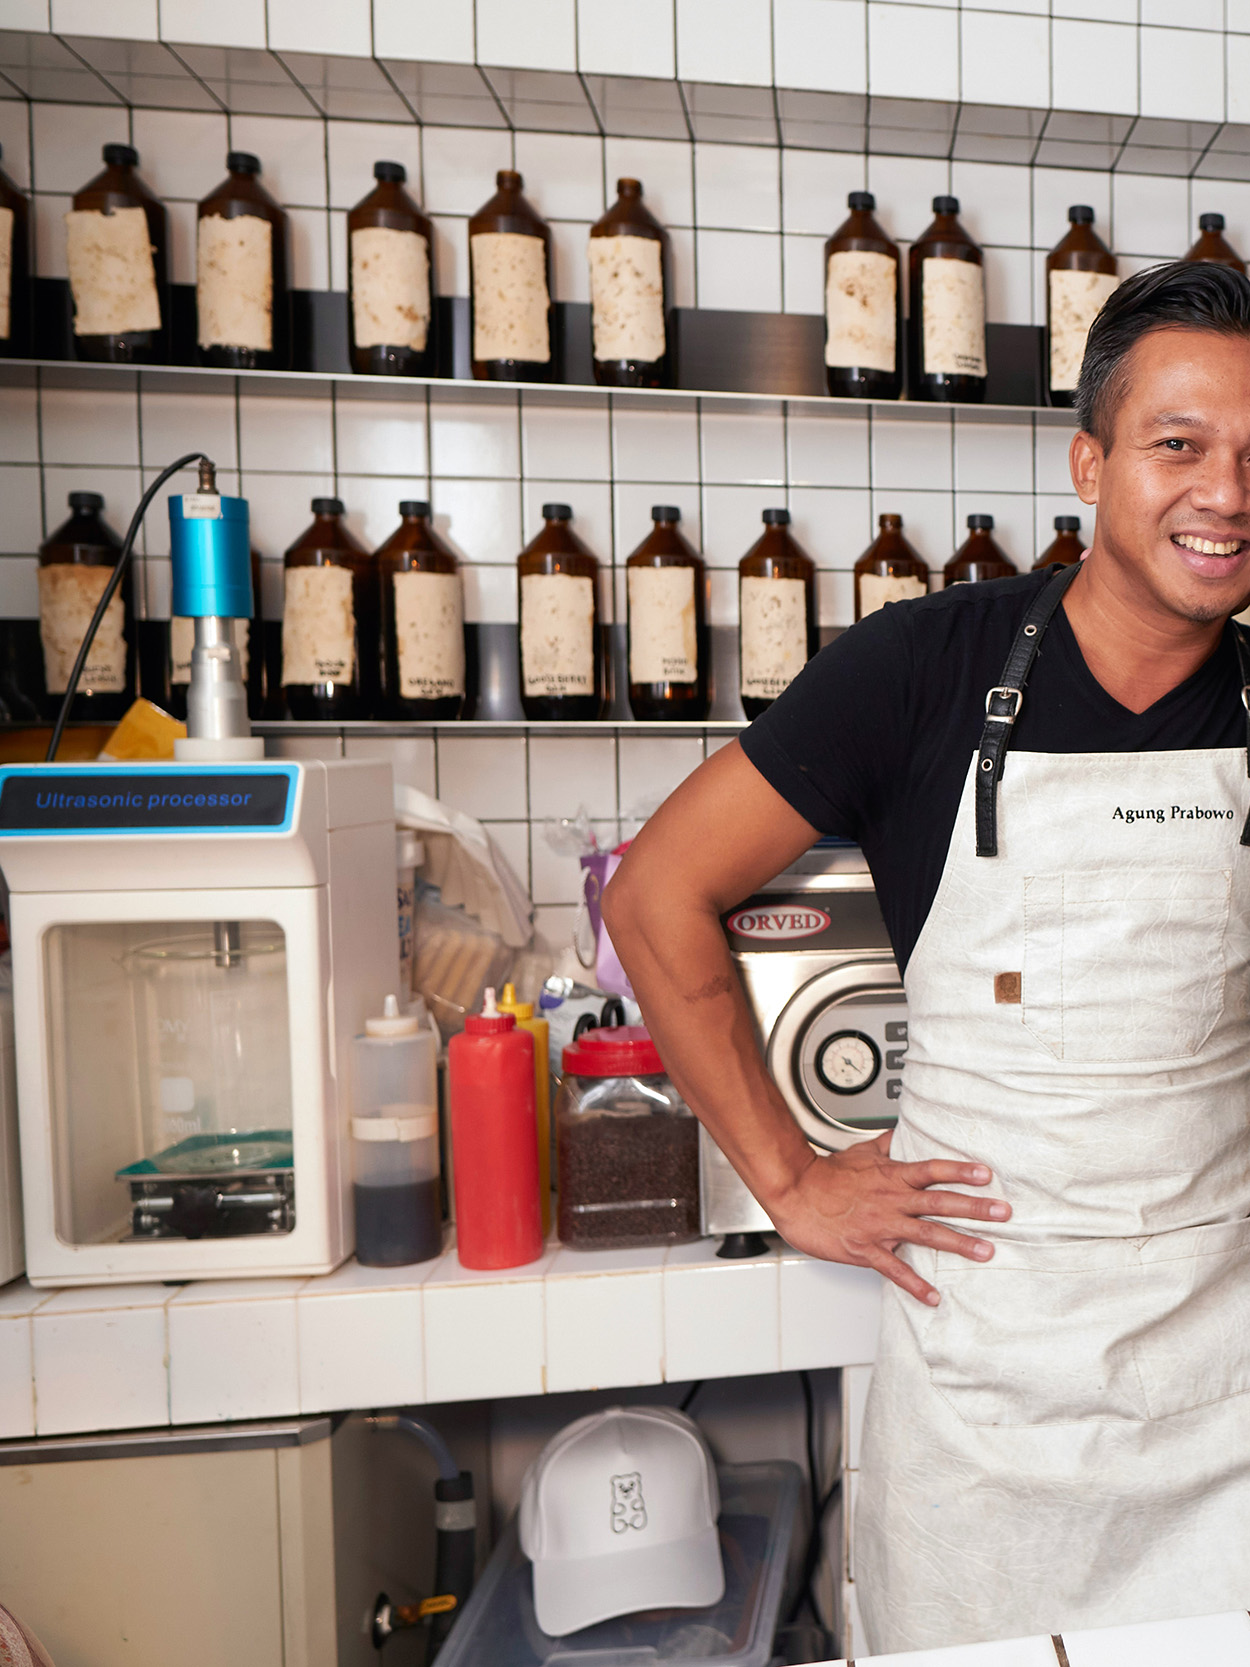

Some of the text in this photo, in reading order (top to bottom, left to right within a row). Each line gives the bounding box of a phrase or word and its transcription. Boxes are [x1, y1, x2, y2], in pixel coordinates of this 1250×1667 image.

[36, 791, 252, 810] Ultrasonic processor
[1112, 805, 1235, 824] Agung Prabowo
[737, 912, 821, 932] ORVED
